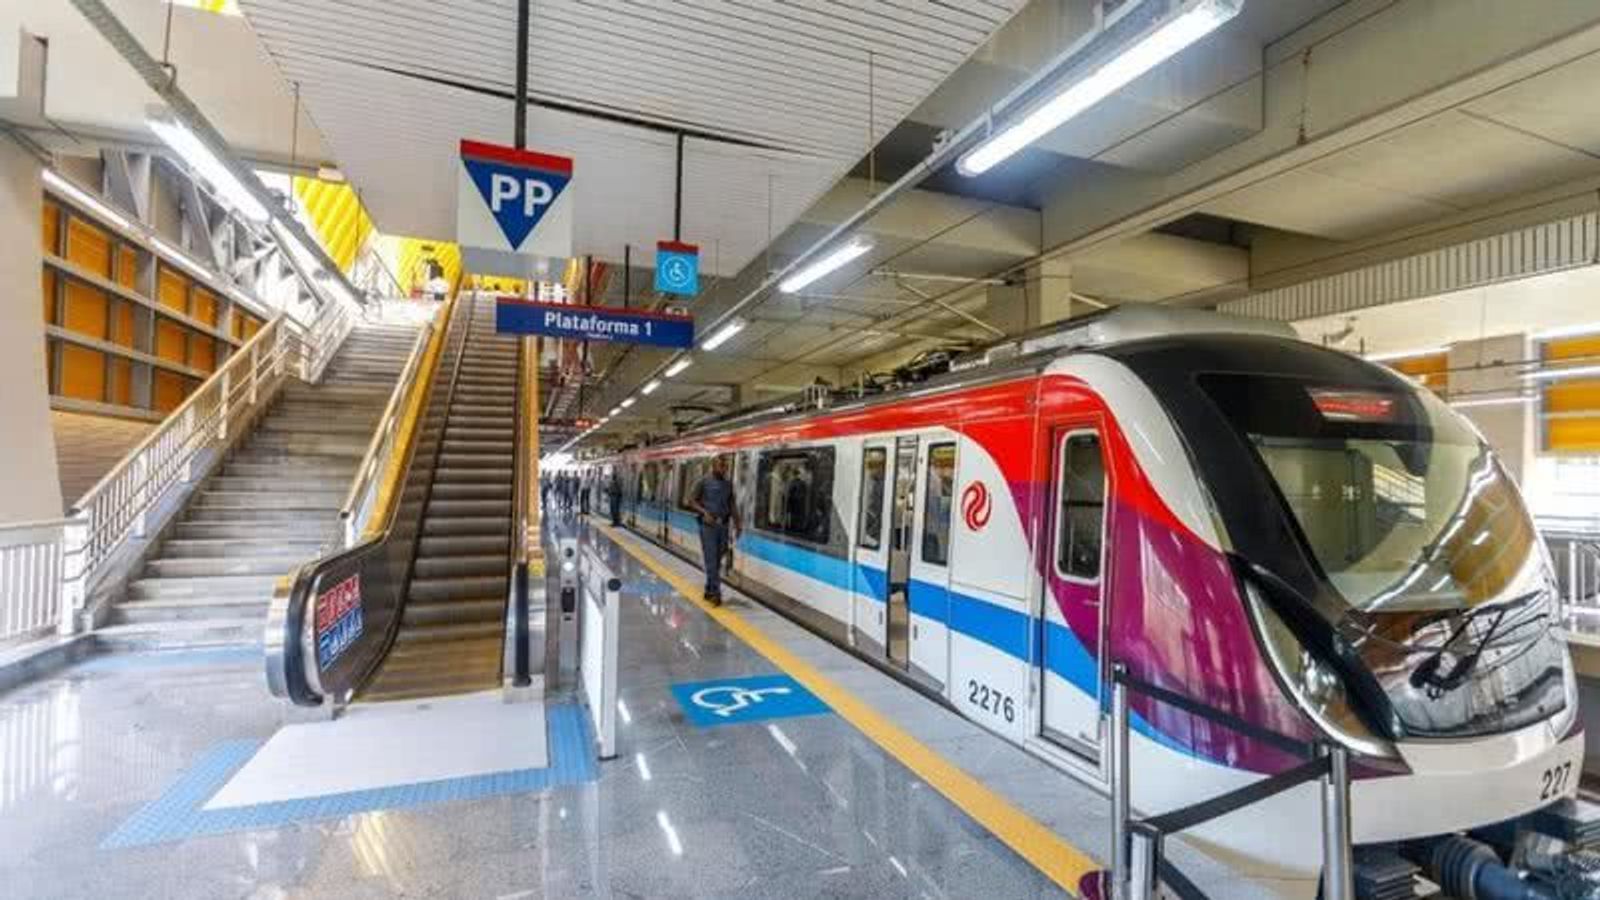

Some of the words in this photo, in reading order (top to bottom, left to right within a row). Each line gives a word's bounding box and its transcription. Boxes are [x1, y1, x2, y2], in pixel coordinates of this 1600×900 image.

[490, 173, 553, 217] PP
[544, 311, 639, 336] Plataforma
[645, 321, 652, 337] 1
[968, 679, 1016, 723] 2276
